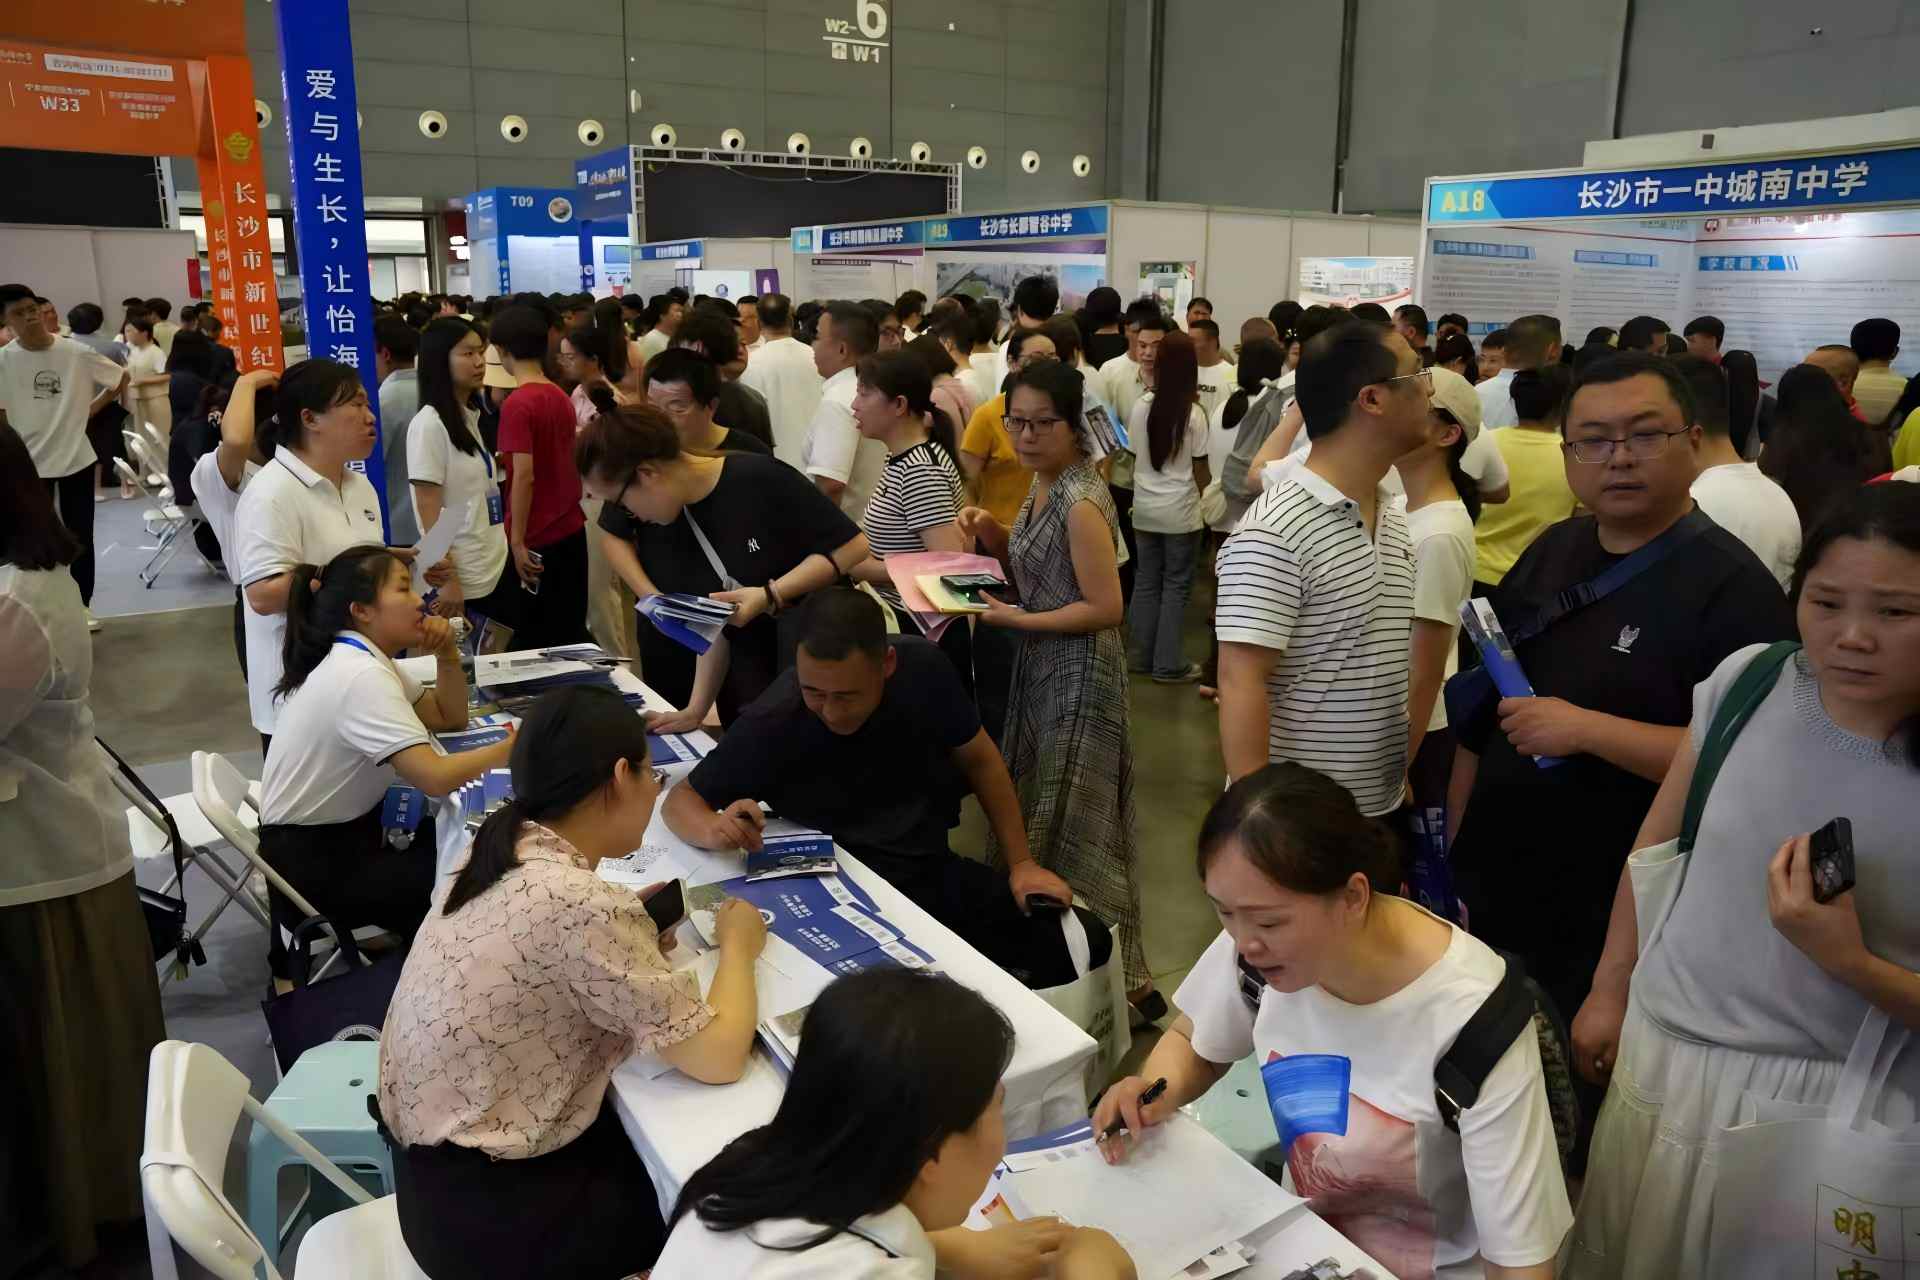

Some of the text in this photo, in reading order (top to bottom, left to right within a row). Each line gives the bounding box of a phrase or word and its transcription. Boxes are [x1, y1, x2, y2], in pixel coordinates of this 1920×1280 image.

[853, 45, 880, 63] W1
[40, 96, 81, 112] W33
[1578, 160, 1870, 209] 长沙市一中城南中学
[1440, 189, 1486, 214] A18
[233, 181, 276, 368] 长沙市新世纪
